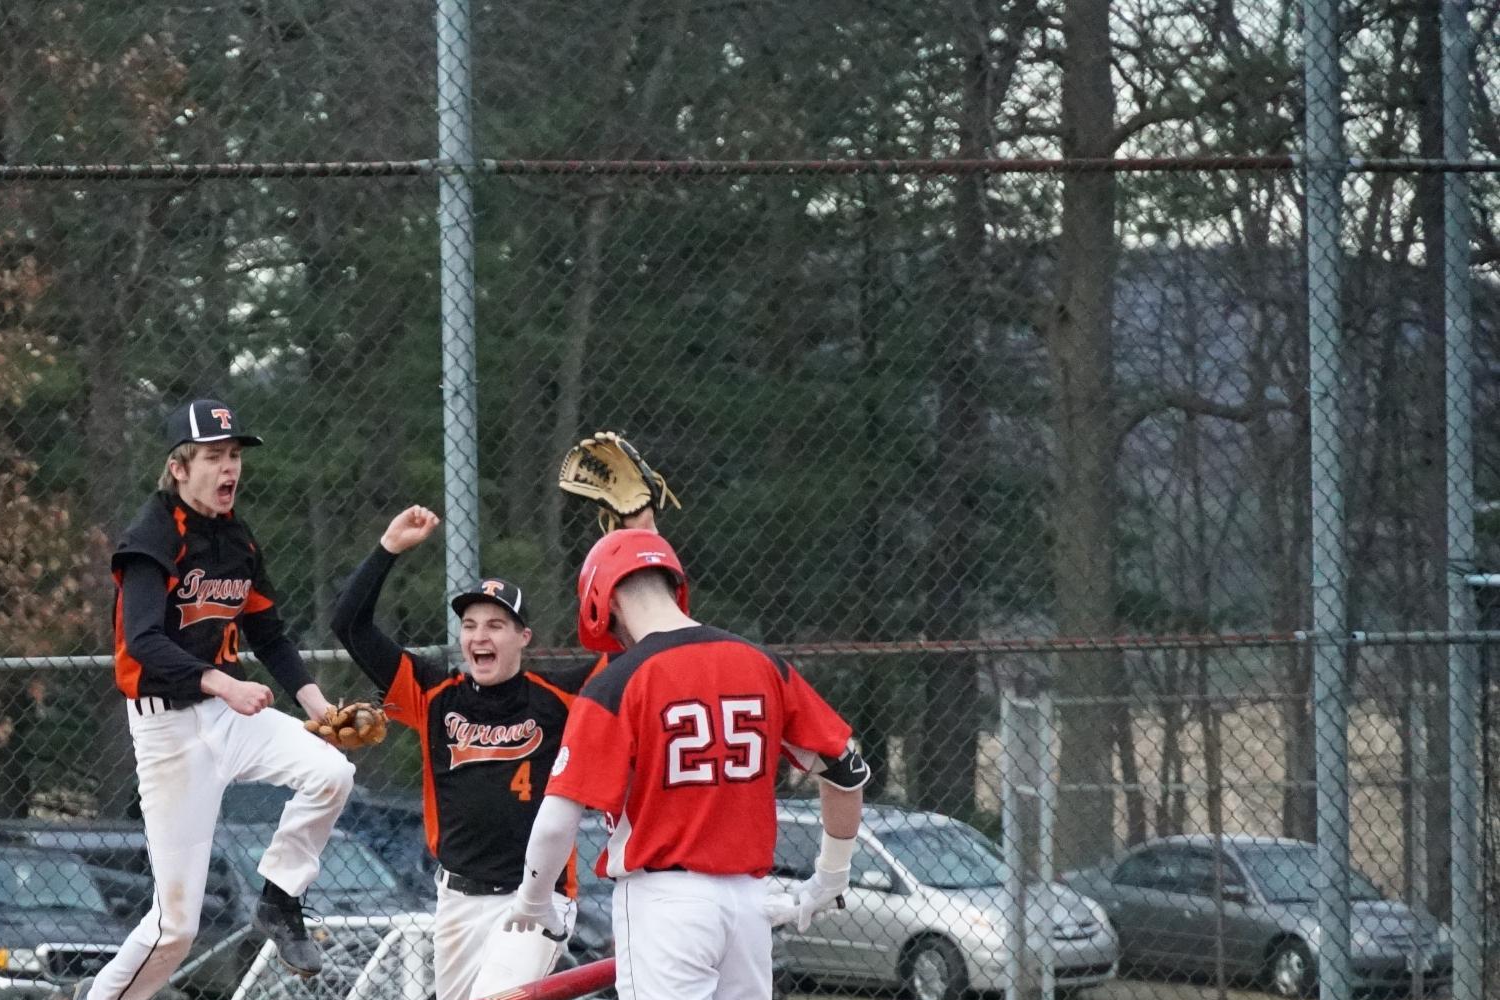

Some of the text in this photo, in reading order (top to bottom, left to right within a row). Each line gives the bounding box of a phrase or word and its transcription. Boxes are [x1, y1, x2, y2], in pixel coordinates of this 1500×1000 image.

[211, 408, 232, 430] T
[177, 568, 252, 609] Tyrone
[481, 580, 505, 597] T
[214, 622, 240, 665] 10
[444, 711, 537, 751] Tyrone
[660, 694, 767, 791] 25
[509, 760, 533, 802] 4
